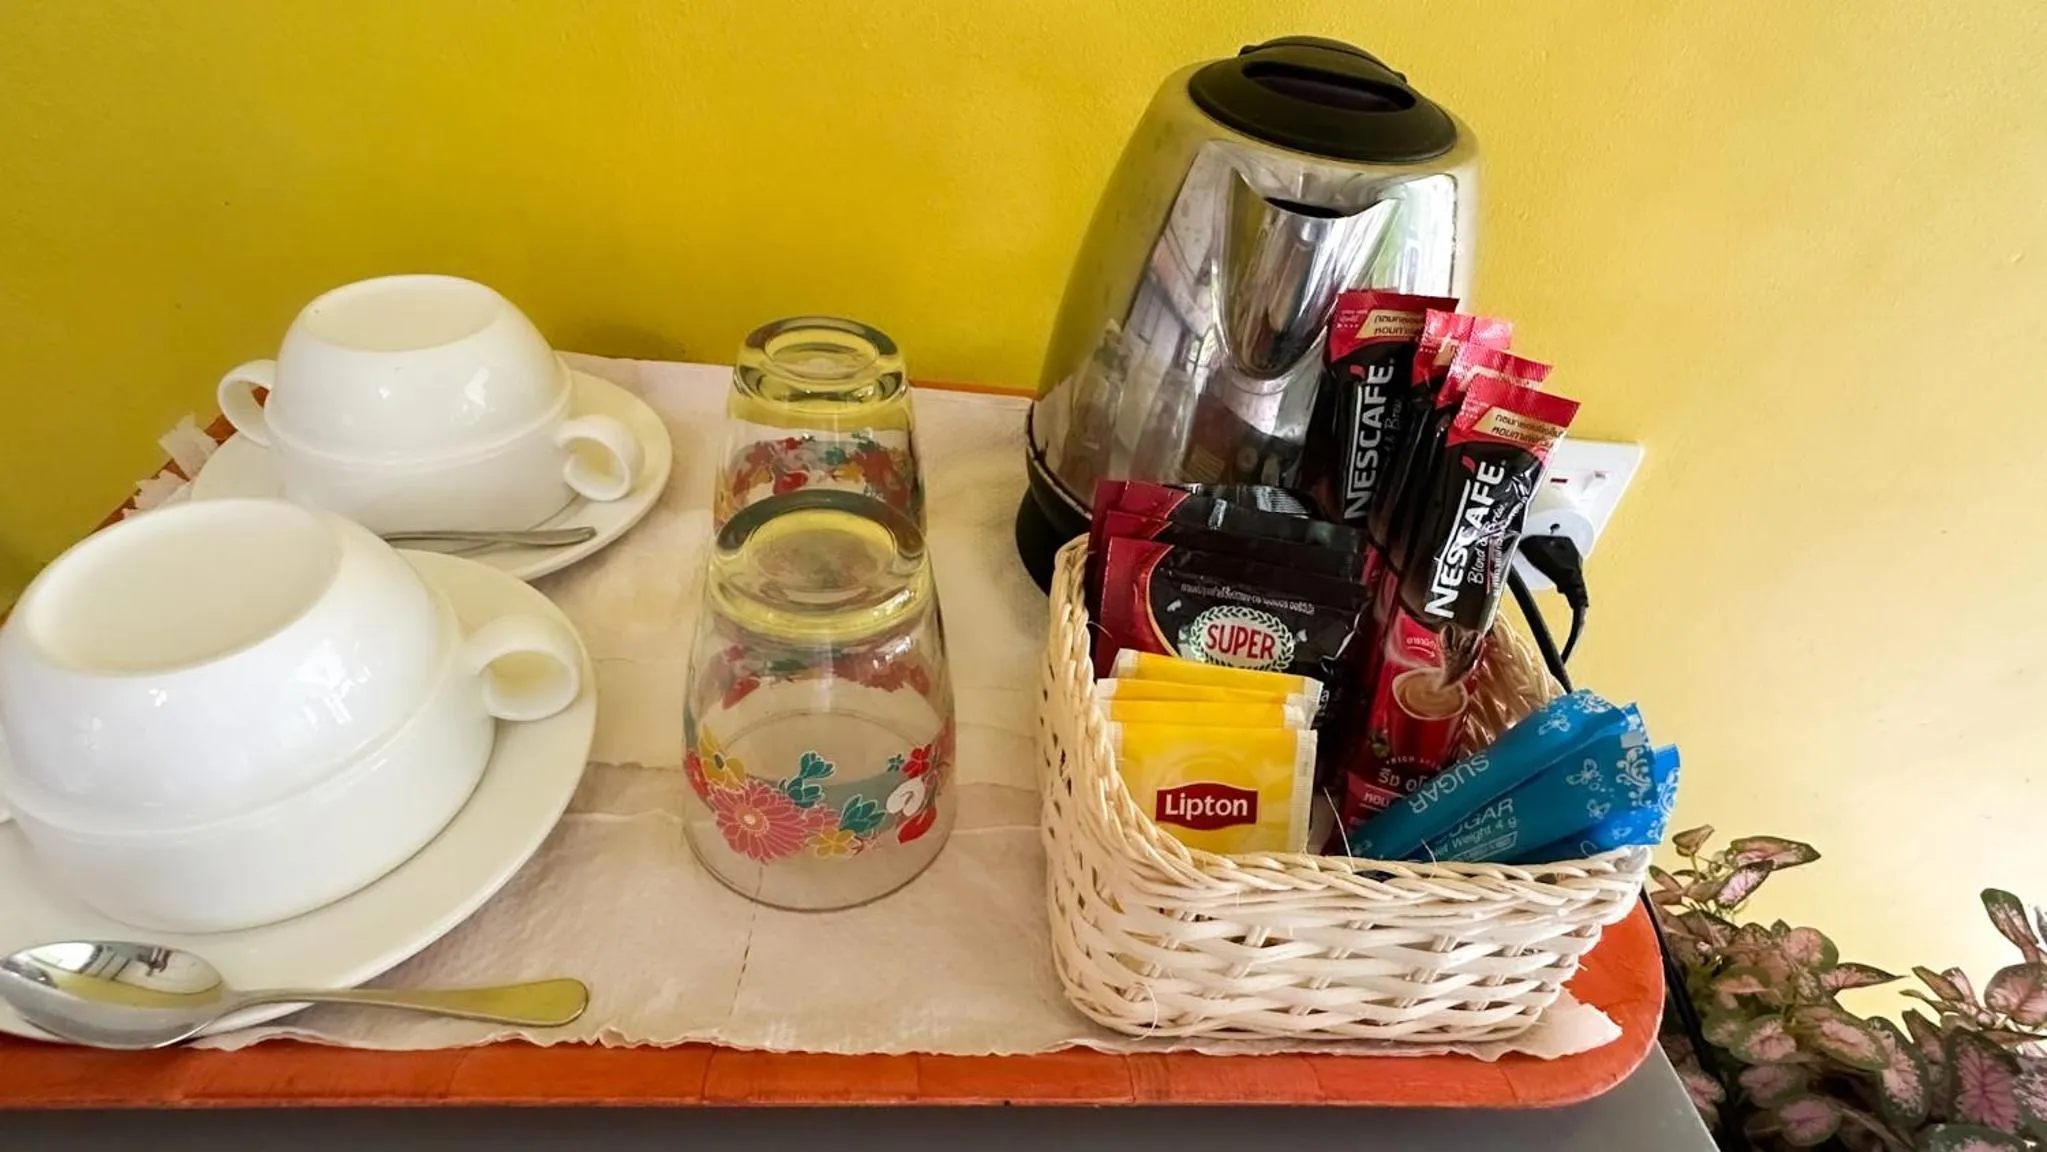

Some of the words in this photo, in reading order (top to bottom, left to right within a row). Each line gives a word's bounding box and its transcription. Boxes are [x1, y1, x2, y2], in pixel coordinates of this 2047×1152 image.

[1205, 623, 1276, 660] SUPER
[1408, 753, 1490, 814] SUGAR
[1165, 792, 1248, 821] Lipton
